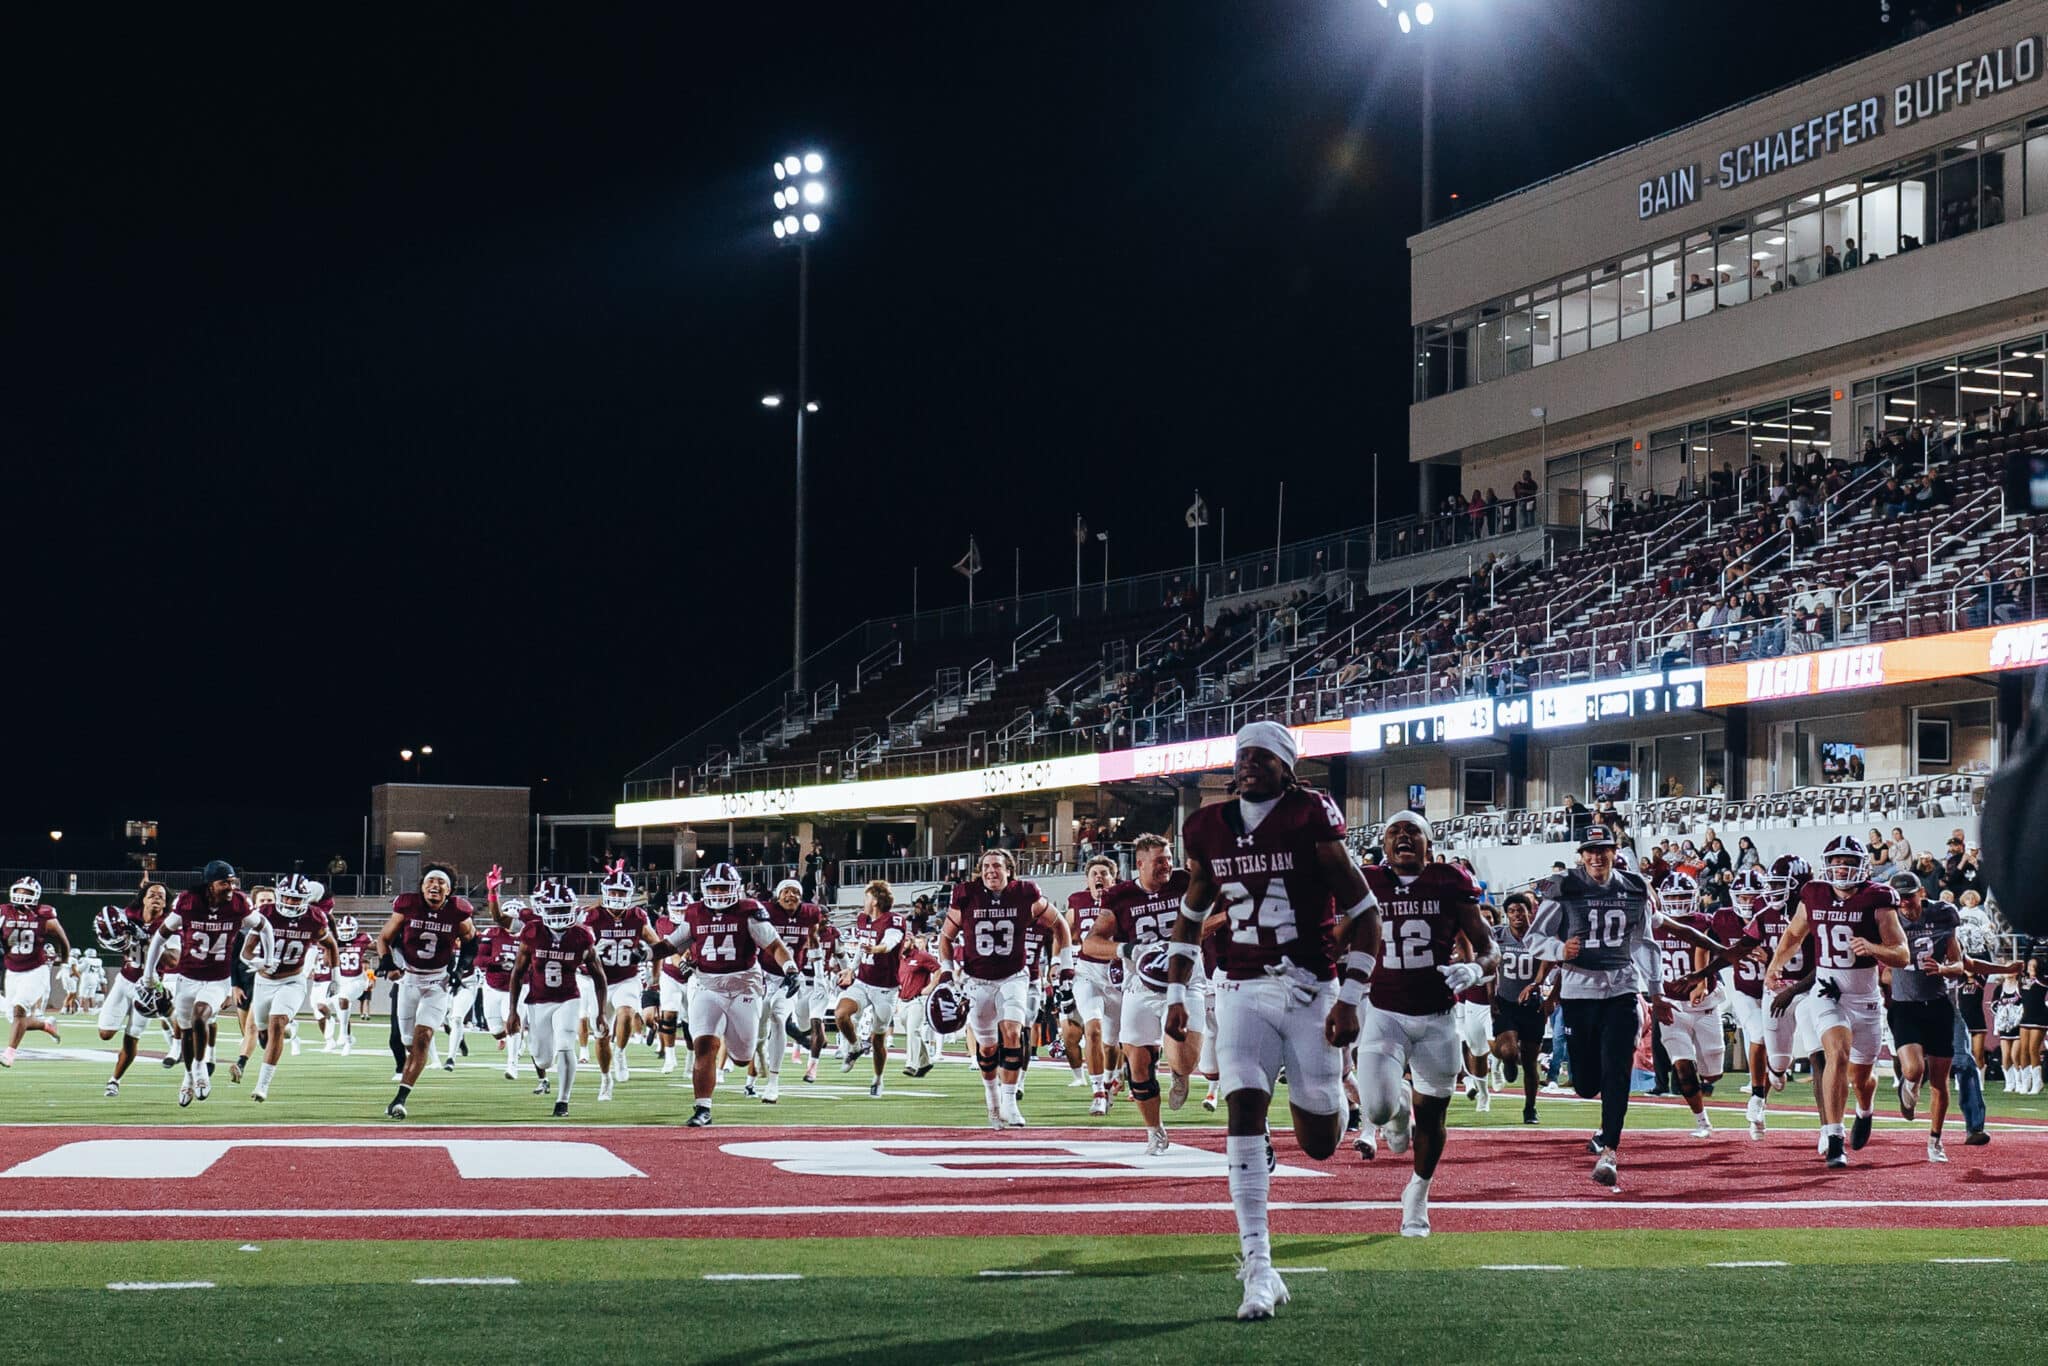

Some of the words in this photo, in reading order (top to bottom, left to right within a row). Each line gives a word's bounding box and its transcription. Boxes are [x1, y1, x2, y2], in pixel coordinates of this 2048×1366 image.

[1638, 165, 1696, 219] BAIN
[1718, 97, 1879, 190] SCHAEFFER
[1893, 37, 2036, 127] BUFFALO
[1211, 858, 1232, 877] WEST
[1235, 854, 1267, 875] TEXAS
[1271, 852, 1294, 872] A&M
[973, 909, 987, 918] WEST
[988, 908, 1005, 918] TEXAS
[1130, 904, 1146, 917] WEST
[1147, 901, 1167, 913] TEXAS
[1220, 877, 1299, 945] 24
[1391, 900, 1419, 916] TEXAS
[1812, 909, 1826, 920] WEST
[1827, 910, 1848, 921] TEXAS
[205, 922, 221, 931] TEXAS
[410, 919, 424, 929] WEST
[424, 921, 441, 931] TEXAS
[695, 925, 709, 934] WEST
[710, 924, 726, 933] TEXAS
[975, 920, 1015, 956] 63
[1585, 909, 1626, 948] 10
[8, 928, 35, 954] 48
[190, 931, 228, 960] 34
[274, 939, 304, 965] 10
[416, 931, 438, 959] 3
[600, 939, 633, 967] 36
[701, 935, 737, 960] 44
[1381, 919, 1434, 969] 12
[1817, 924, 1856, 968] 19
[340, 952, 361, 971] 93
[535, 949, 548, 958] WEST
[548, 950, 563, 960] TEXAS
[1503, 952, 1534, 980] 20
[1661, 950, 1691, 982] 60
